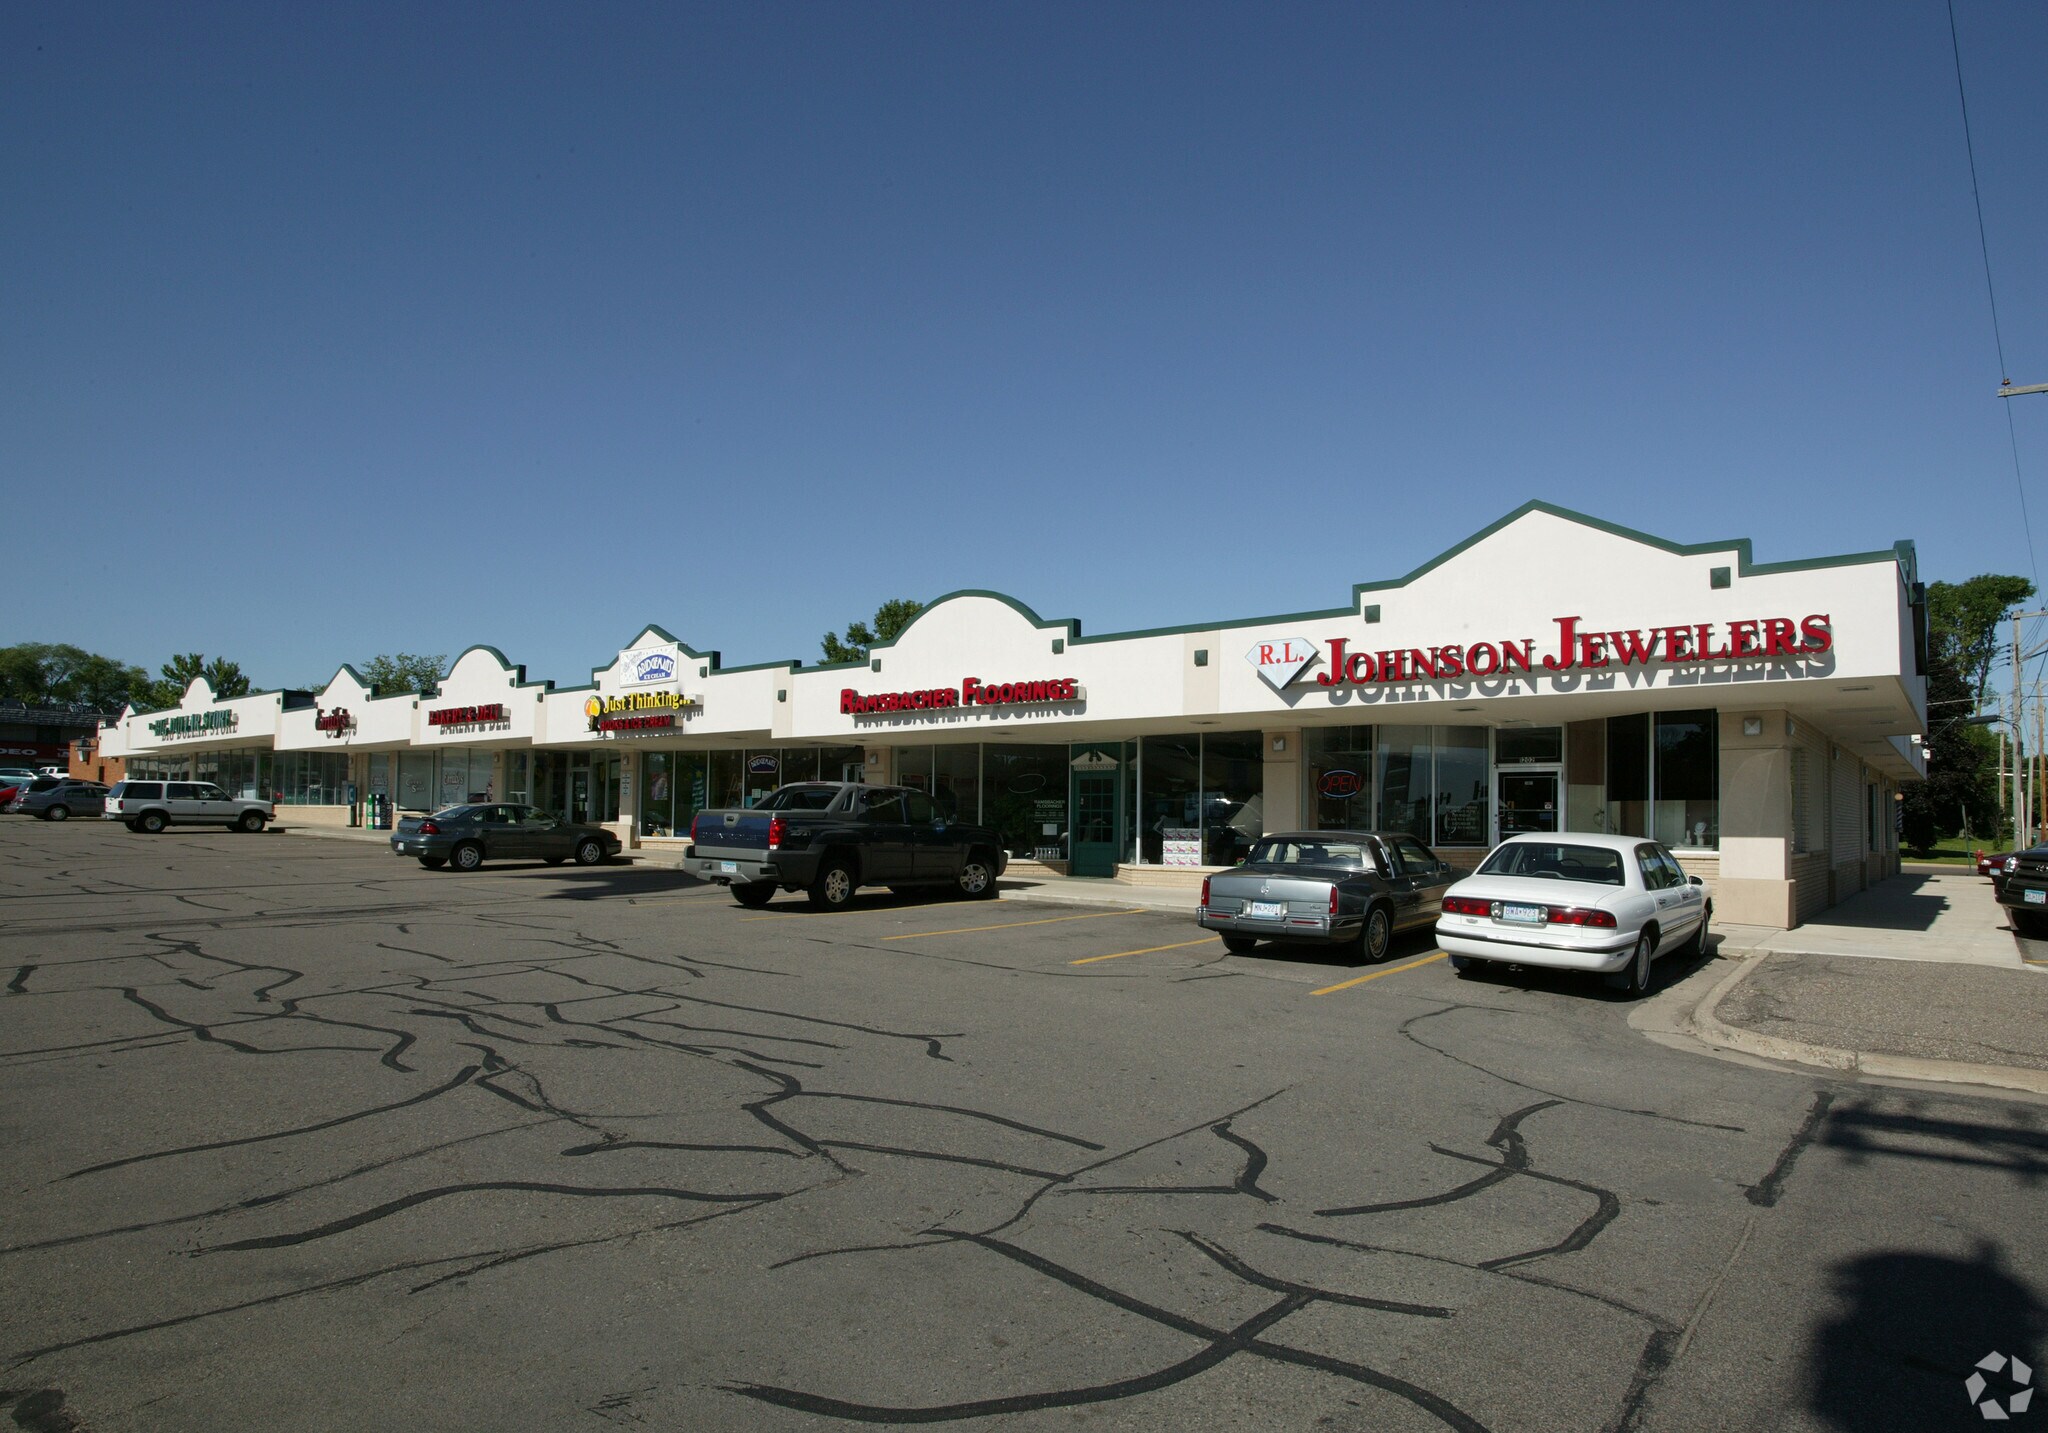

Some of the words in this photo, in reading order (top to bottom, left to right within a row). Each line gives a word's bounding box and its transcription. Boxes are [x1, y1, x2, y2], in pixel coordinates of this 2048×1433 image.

[1259, 642, 1304, 665] R.L.
[1317, 638, 1534, 687] JOHNSON
[1542, 614, 1833, 671] JEWELERS
[603, 695, 626, 714] Just
[840, 688, 958, 714] RAMSBACHER
[963, 677, 1079, 706] FLOORINGS
[1317, 776, 1361, 792] OPEN
